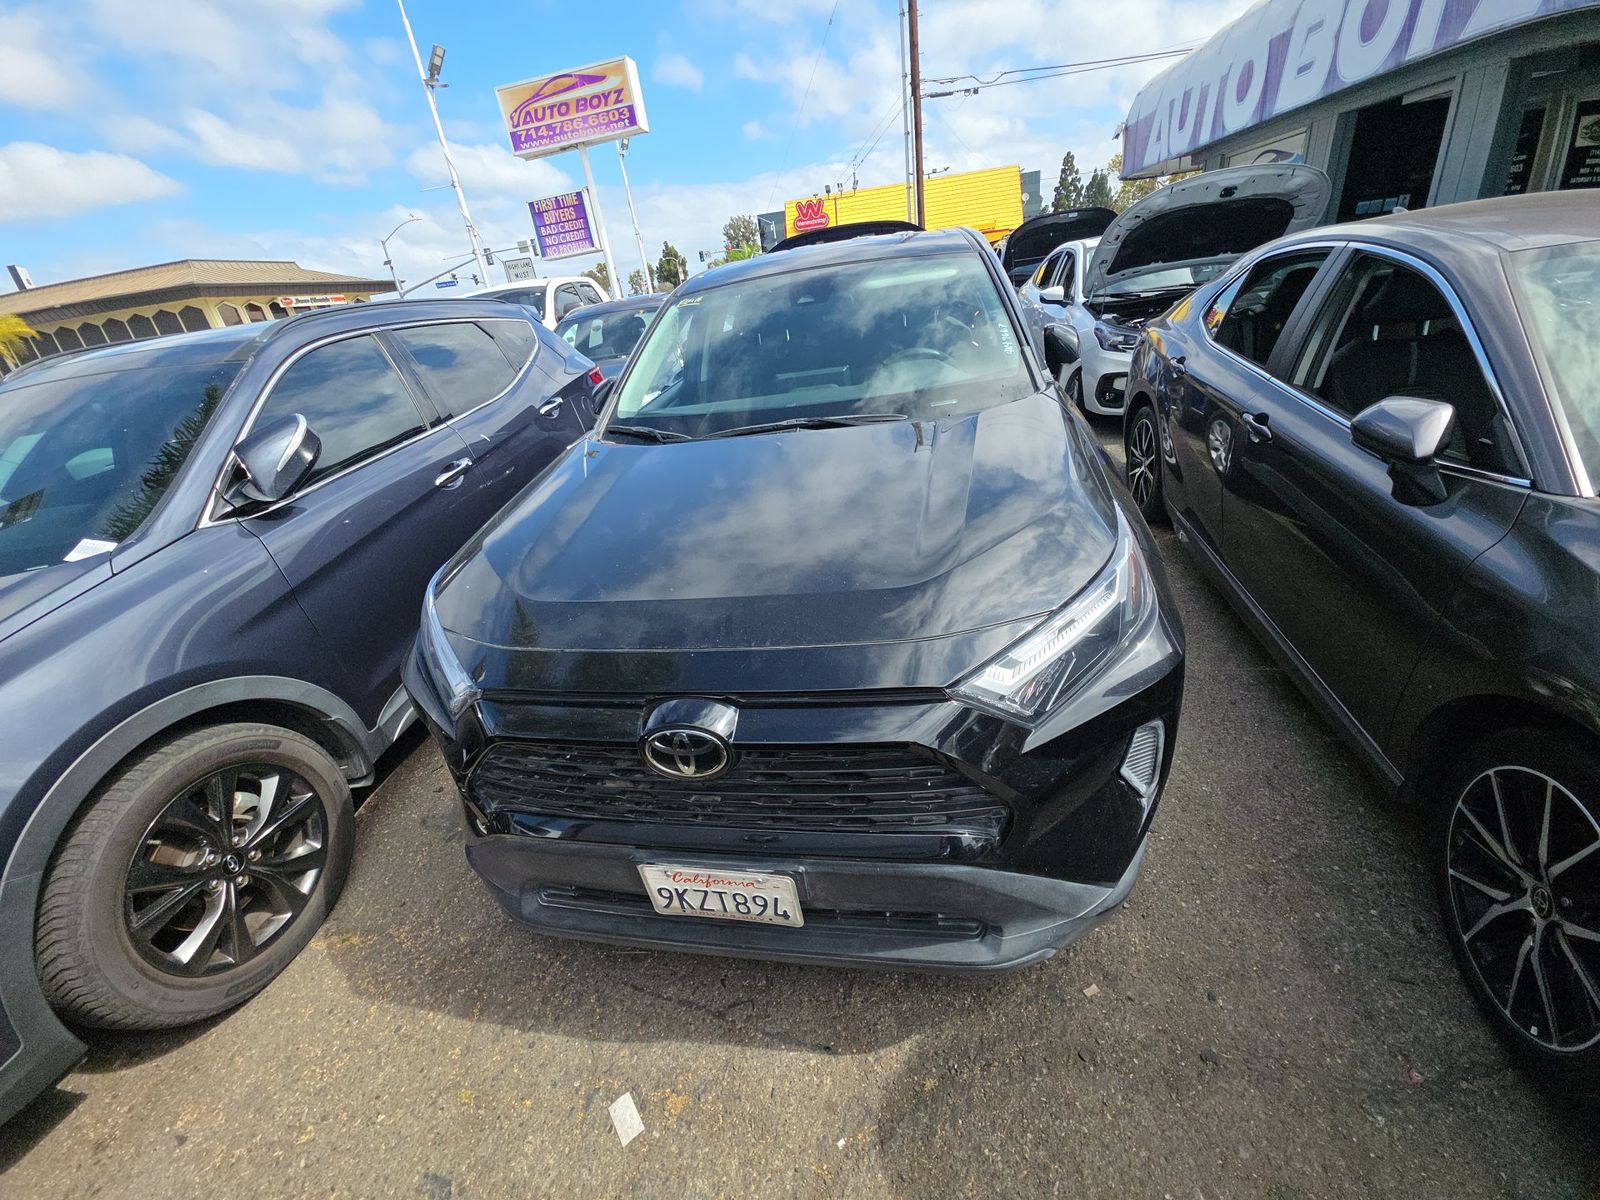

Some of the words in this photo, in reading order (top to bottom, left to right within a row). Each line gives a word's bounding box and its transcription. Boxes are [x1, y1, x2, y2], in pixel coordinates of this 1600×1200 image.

[522, 102, 570, 126] AUTO
[576, 88, 624, 113] BOYZ
[1143, 35, 1270, 168] AUTO
[518, 107, 630, 142] 714.786.6603
[520, 119, 630, 149] www.autoboyz.net
[533, 197, 557, 213] FIRST
[557, 193, 579, 208] TIME
[543, 207, 576, 225] BUYERS
[541, 224, 558, 236] BAD
[558, 219, 584, 233] CREDIT
[545, 236, 558, 246] NO
[559, 229, 586, 243] CREDIT
[546, 246, 559, 257] NO
[559, 240, 591, 254] PROBLEM
[514, 270, 529, 279] MUST
[672, 871, 766, 889] California
[657, 887, 791, 920] 9KZT894
